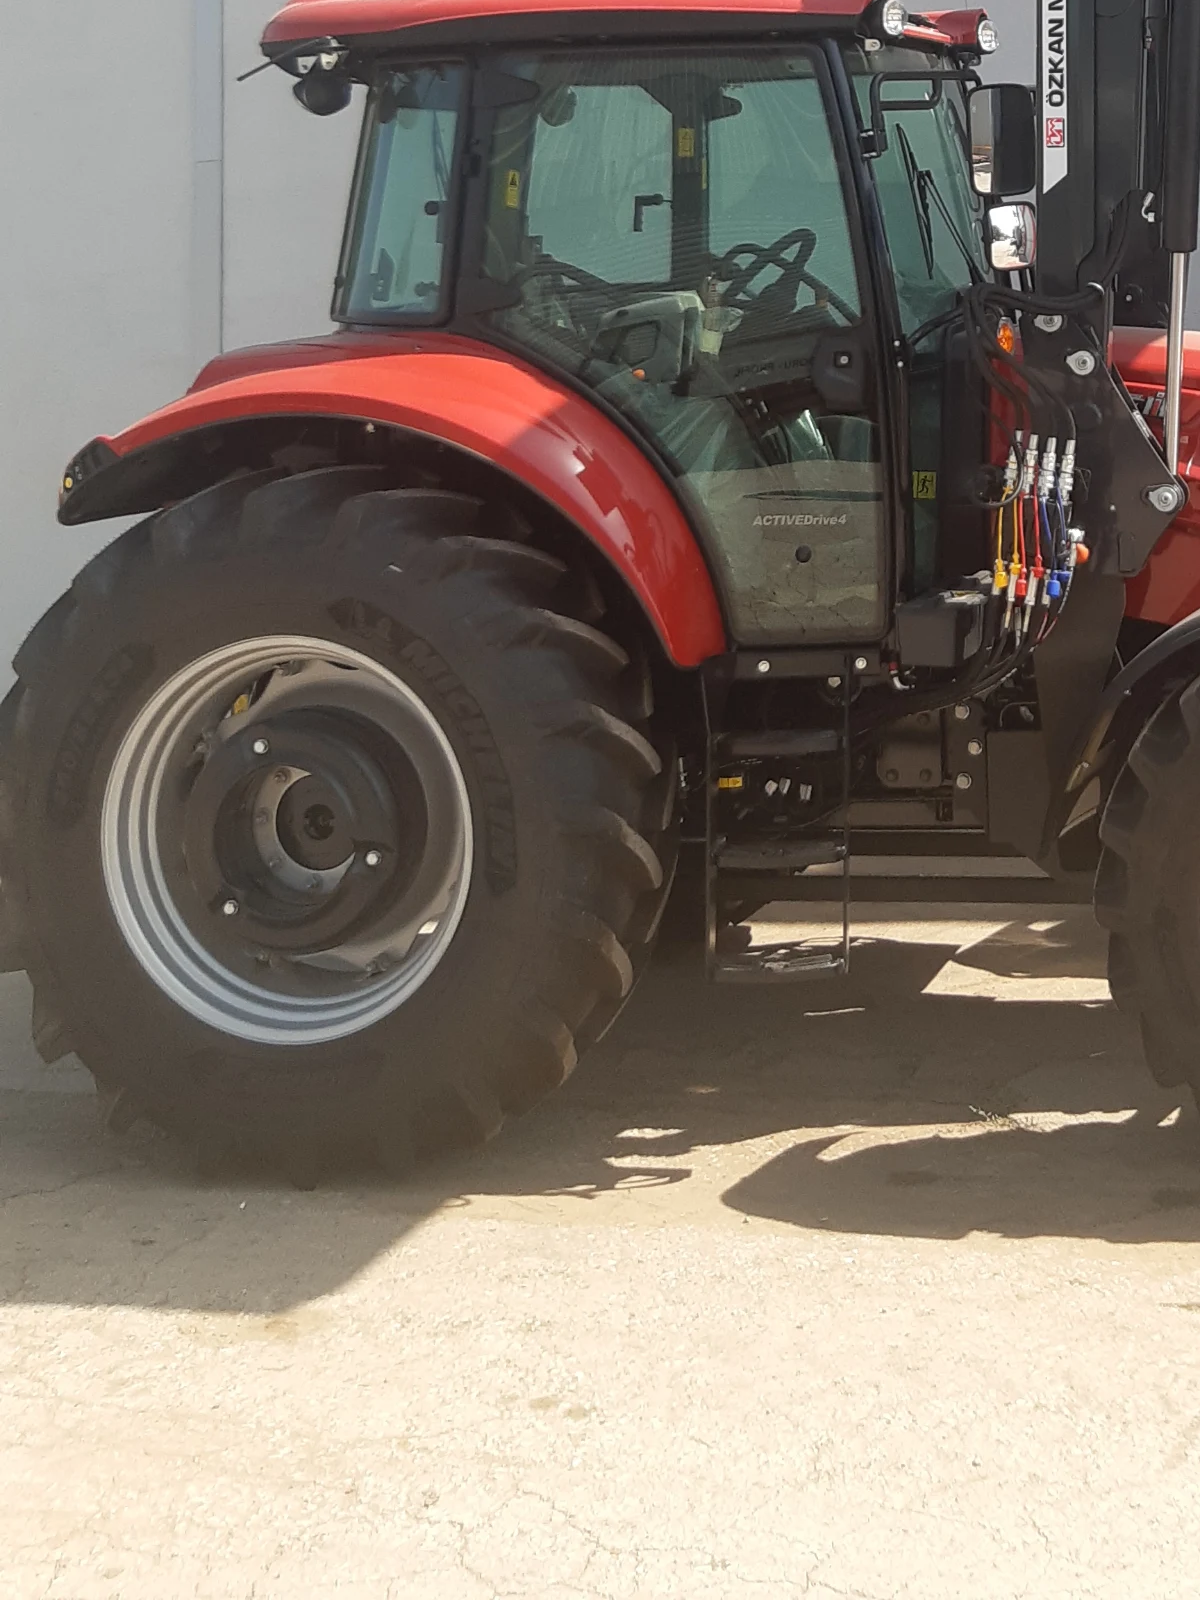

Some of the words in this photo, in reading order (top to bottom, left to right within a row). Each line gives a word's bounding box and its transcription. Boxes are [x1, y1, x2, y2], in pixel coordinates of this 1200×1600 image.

[1046, 18, 1065, 108] ÖZKAN
[752, 513, 847, 526] ACTIVEDrive4
[401, 635, 513, 872] MICHELIN
